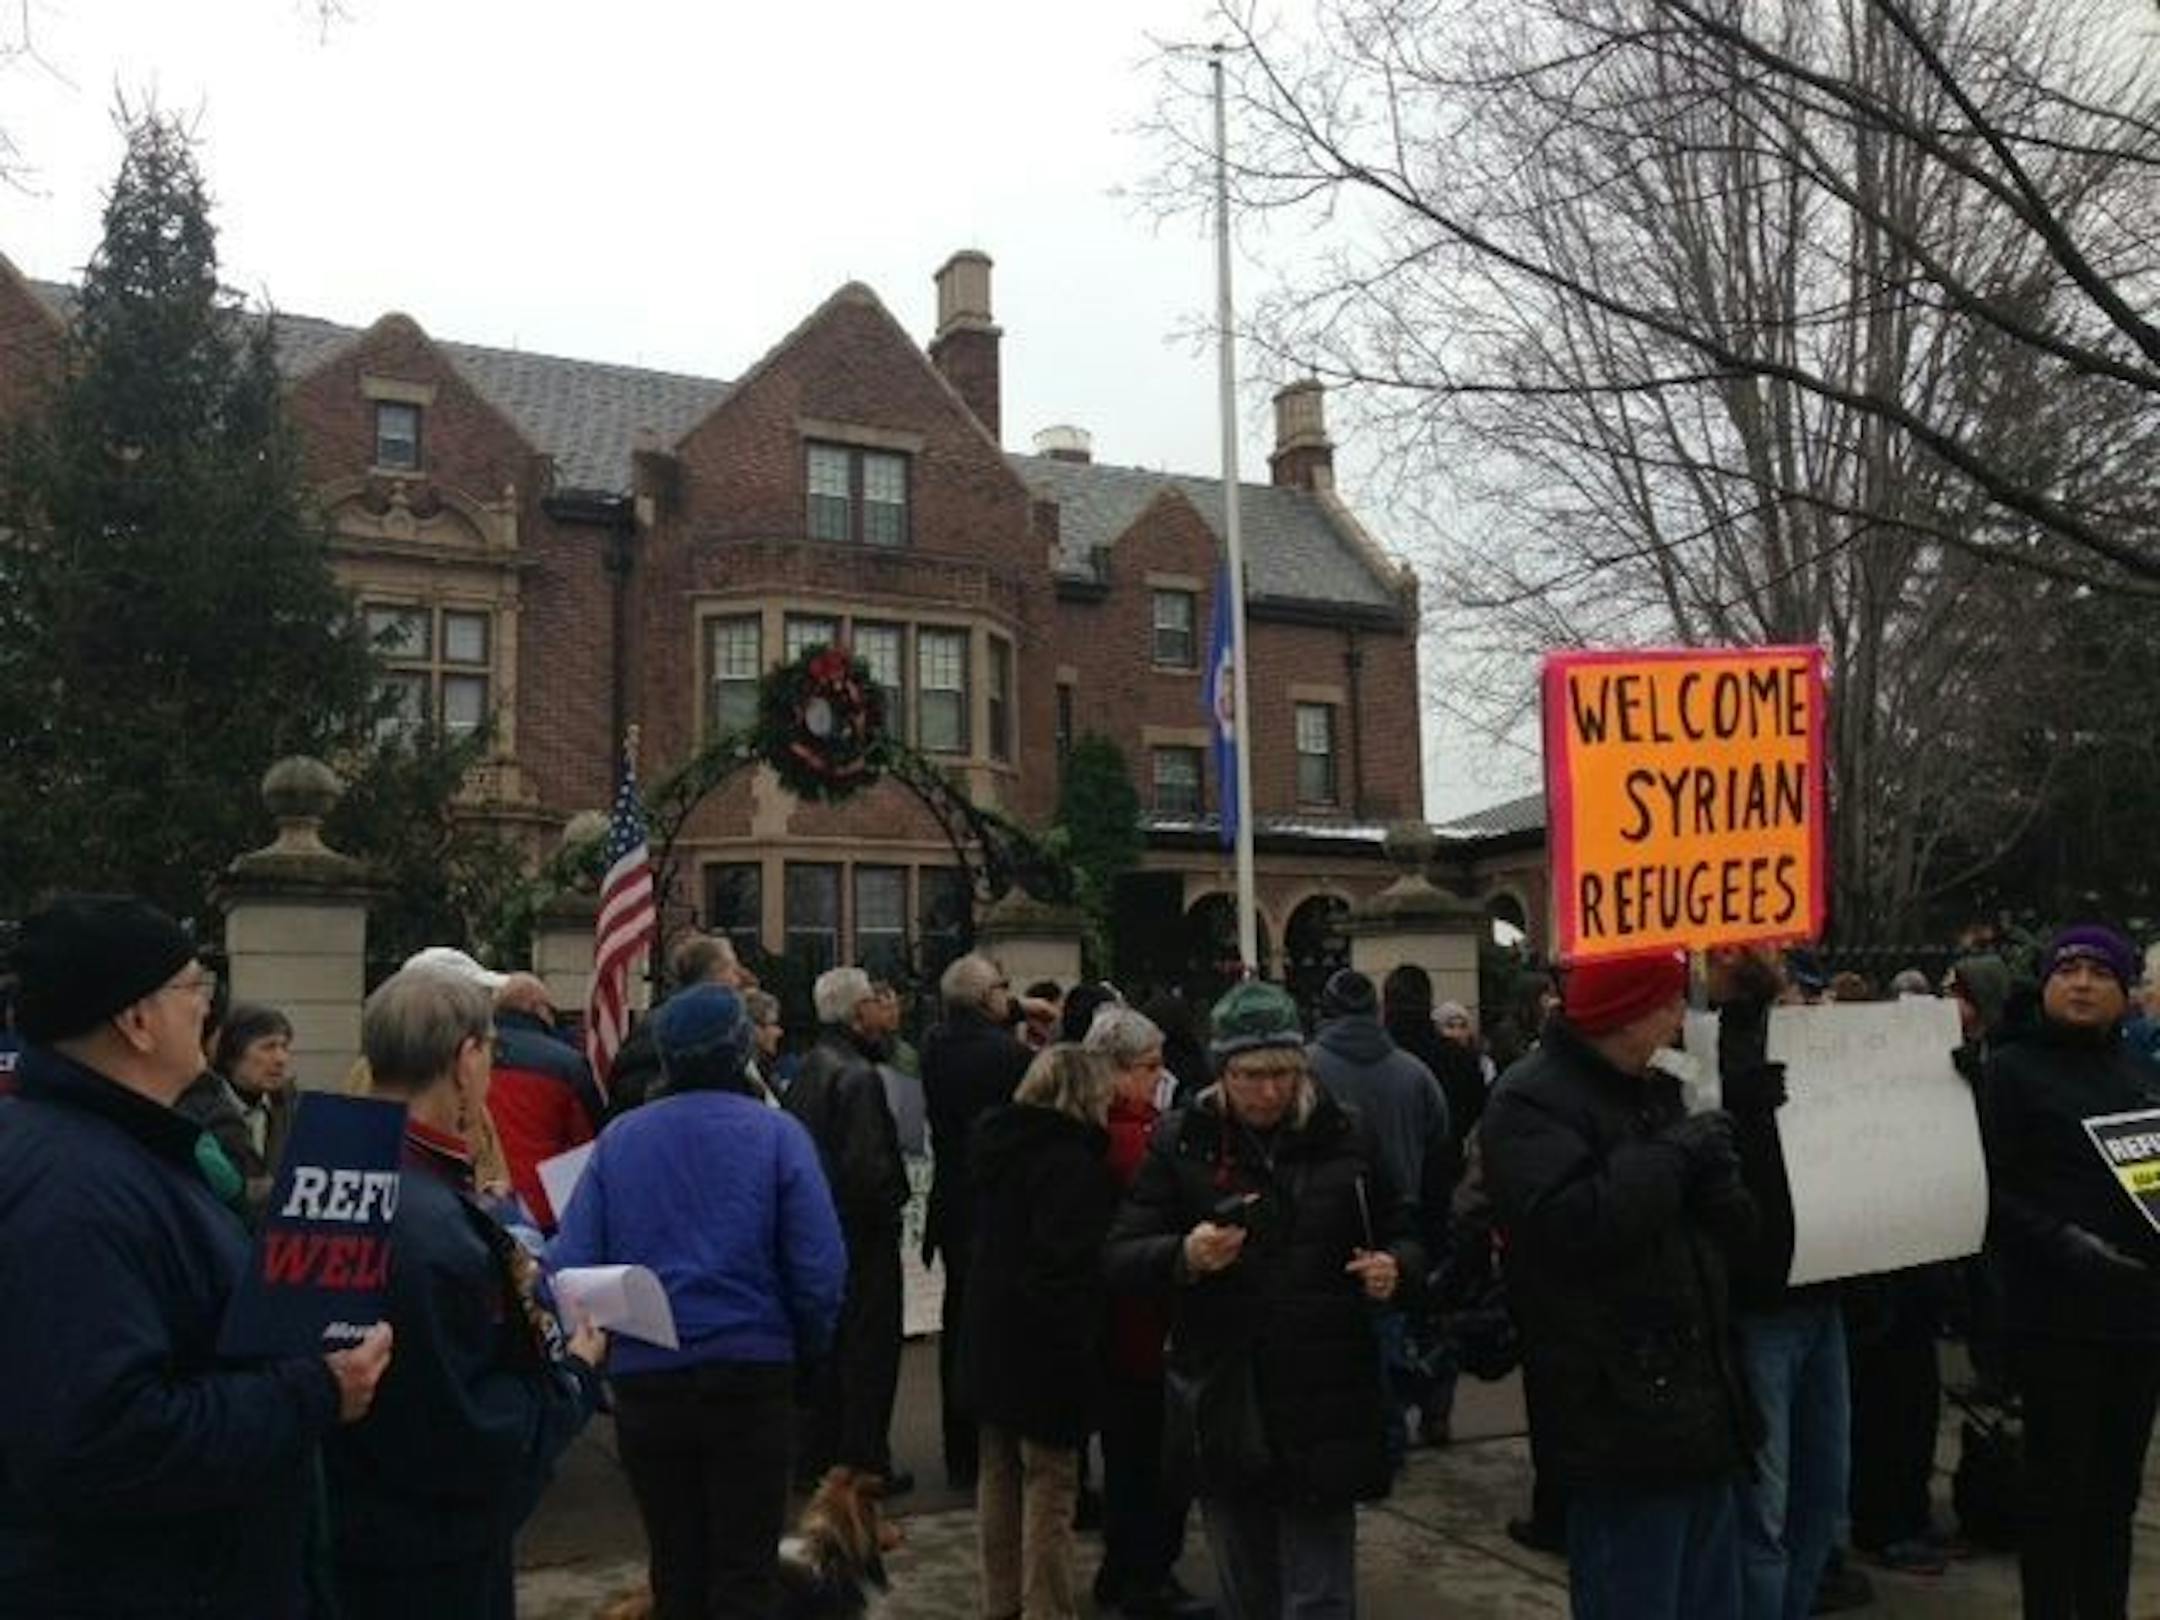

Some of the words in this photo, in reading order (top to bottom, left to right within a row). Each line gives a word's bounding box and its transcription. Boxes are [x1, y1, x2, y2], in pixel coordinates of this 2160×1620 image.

[1569, 668, 1808, 745] WELCOME
[1620, 760, 1805, 842] SYRIAN
[1580, 854, 1797, 938] REFUGEES
